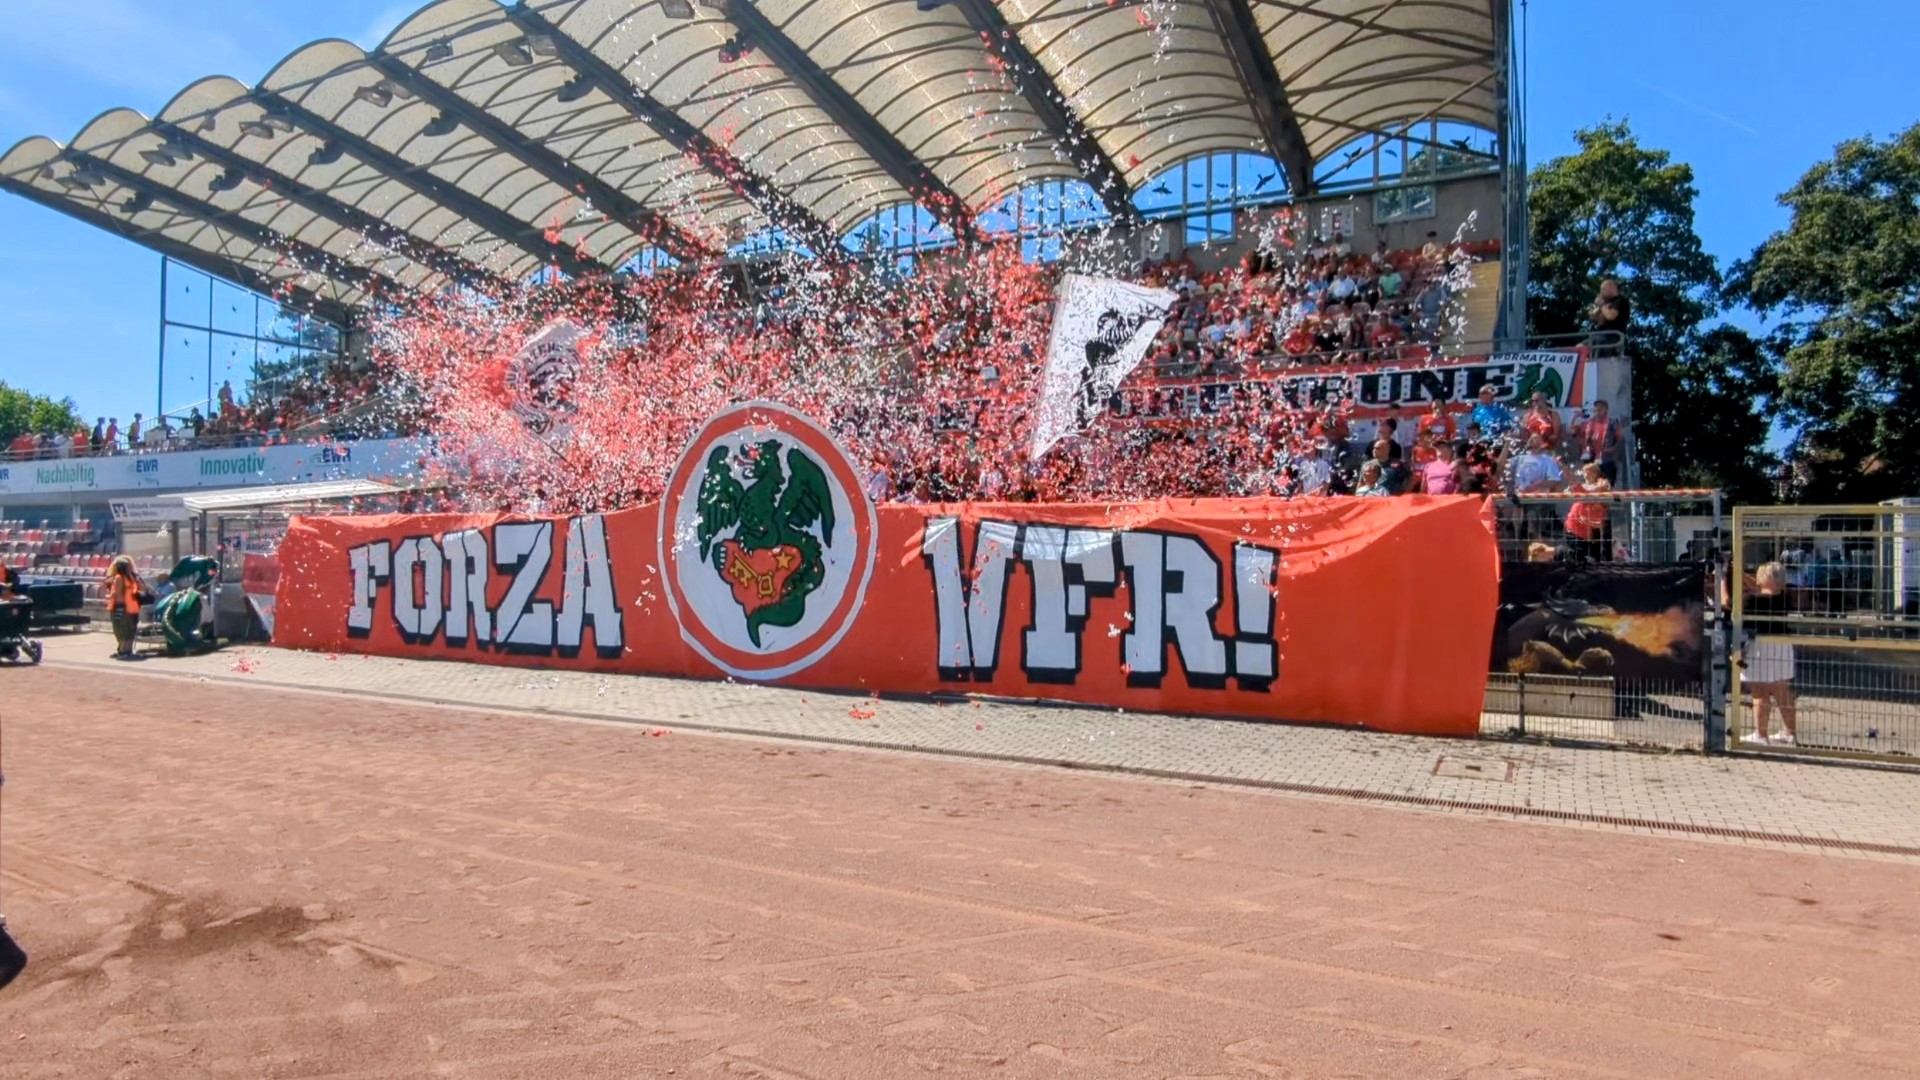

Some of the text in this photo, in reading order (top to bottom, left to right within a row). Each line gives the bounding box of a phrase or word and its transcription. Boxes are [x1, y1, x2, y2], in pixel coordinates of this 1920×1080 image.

[1494, 351, 1575, 364] WORMATIA 08
[36, 462, 96, 487] Nachhaltig
[135, 458, 159, 473] EWR
[200, 452, 264, 476] Innovativ
[346, 515, 624, 658] FORZA
[922, 515, 1281, 692] VFR!
